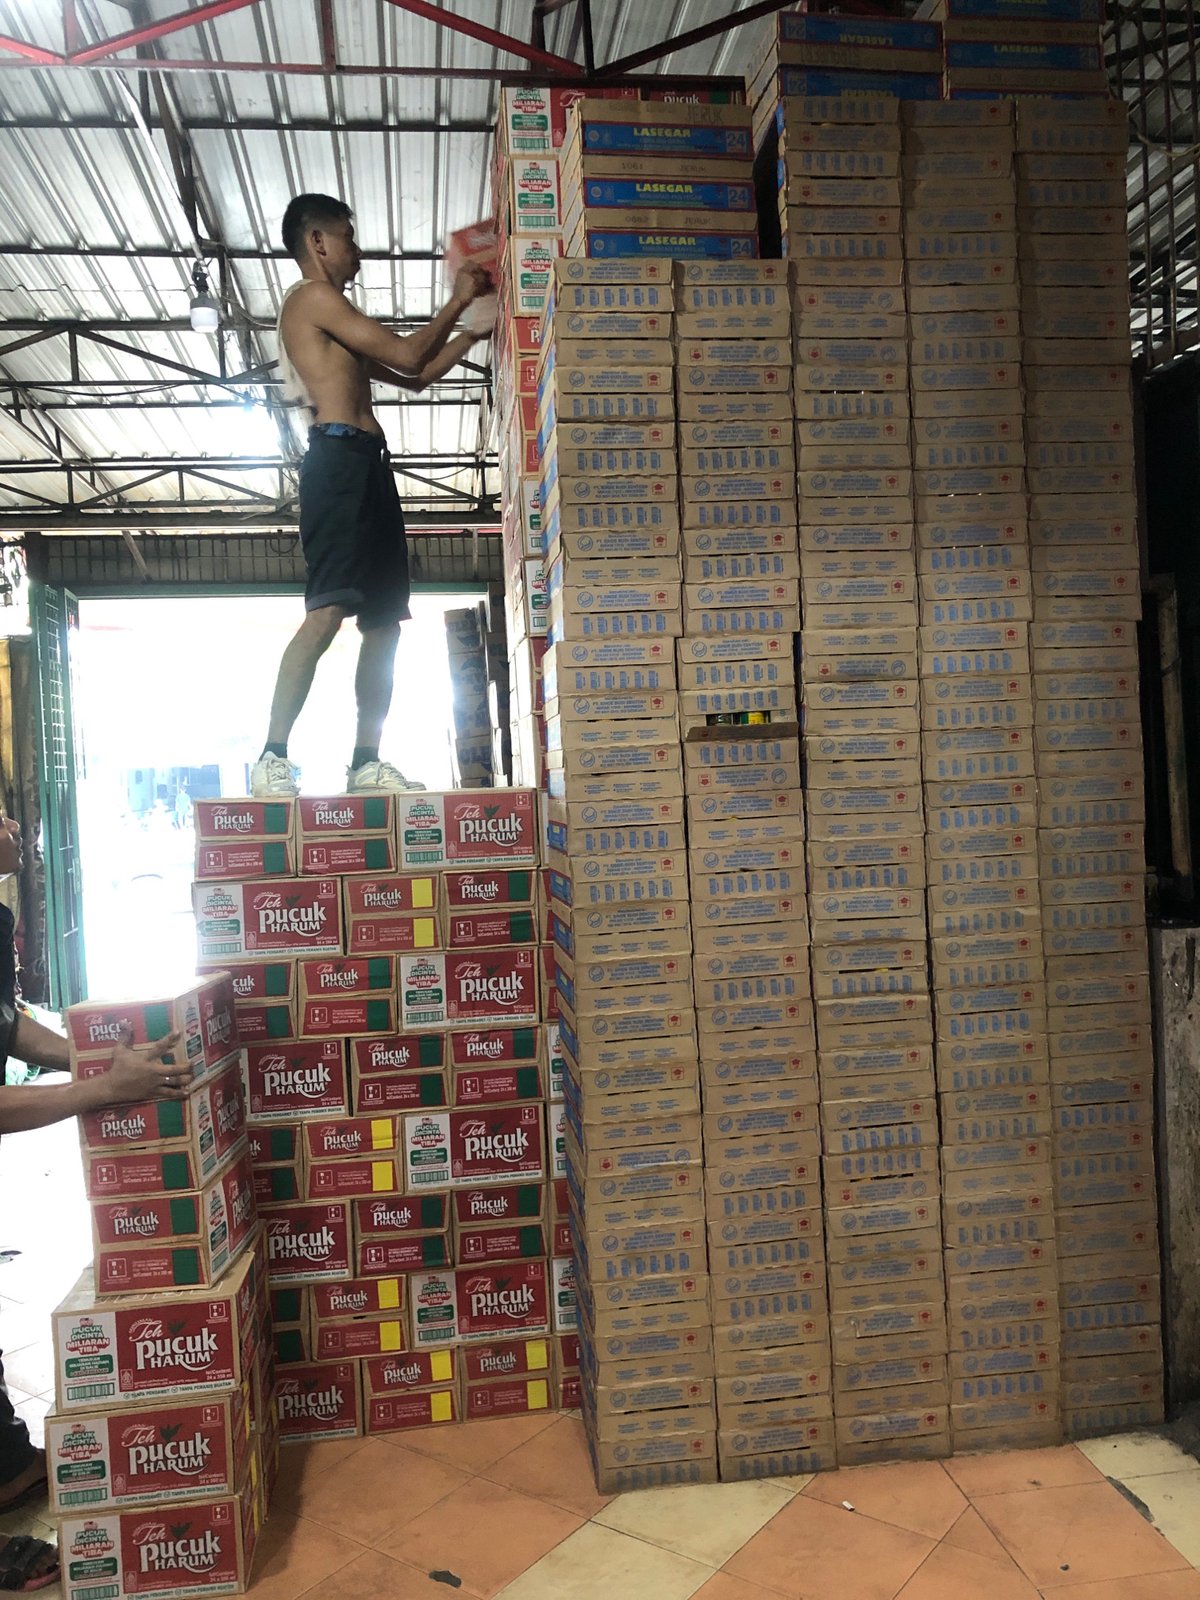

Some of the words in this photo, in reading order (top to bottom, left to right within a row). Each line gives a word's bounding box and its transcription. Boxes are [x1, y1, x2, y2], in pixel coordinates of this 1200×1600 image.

[633, 127, 691, 138] LASEGAR
[636, 183, 693, 194] LASEGAR
[729, 188, 748, 200] 24
[639, 235, 696, 246] LASEGAR
[732, 240, 750, 254] 24
[211, 806, 228, 816] Teh
[315, 808, 354, 825] pucuk
[454, 804, 480, 820] Teh
[214, 812, 254, 829] pucuk
[221, 823, 252, 832] HARUM
[322, 817, 352, 827] HARUM
[460, 813, 523, 843] pucuk
[471, 832, 520, 846] HARUM
[364, 889, 402, 906] pucuk
[462, 881, 499, 899] pucuk
[468, 890, 497, 900] HARUM
[253, 893, 281, 910] Teh
[370, 899, 400, 908] HARUM
[259, 901, 327, 933] pucuk
[271, 922, 323, 937] HARUM
[320, 969, 358, 987] pucuk
[455, 962, 481, 979] Teh
[233, 975, 255, 986] cuk
[460, 971, 524, 1002] pucuk
[233, 985, 252, 995] RUM
[472, 990, 520, 1005] HARUM
[466, 1038, 504, 1056] pucuk
[473, 1048, 502, 1058] HARUM
[259, 1055, 286, 1072] Teh
[372, 1047, 410, 1066] pucuk
[378, 1057, 408, 1067] HARUM
[264, 1063, 331, 1096] pucuk
[276, 1082, 328, 1098] HARUM
[101, 1114, 146, 1138] pucuk
[109, 1129, 143, 1139] HARUM
[460, 1120, 487, 1138] Teh
[324, 1131, 362, 1150] pucuk
[330, 1142, 359, 1151] HARUM
[411, 1134, 445, 1142] MILIARAN
[465, 1128, 528, 1160] pucuk
[477, 1147, 524, 1162] HARUM
[471, 1196, 508, 1215] pucuk
[477, 1206, 506, 1216] HARUM
[114, 1211, 159, 1235] pucuk
[373, 1207, 411, 1225] pucuk
[379, 1217, 409, 1227] HARUM
[122, 1224, 156, 1236] HARUM
[269, 1226, 335, 1259] pucuk
[281, 1246, 332, 1261] HARUM
[465, 1277, 492, 1294] Teh
[471, 1284, 535, 1316] pucuk
[483, 1303, 531, 1318] HARUM
[71, 1332, 104, 1341] DICINTA
[72, 1325, 103, 1334] PUCUK
[129, 1321, 163, 1342] Teh
[66, 1338, 110, 1350] MILIARAN
[79, 1345, 99, 1354] TIBA
[135, 1328, 218, 1370] pucuk
[151, 1352, 214, 1371] HARUM
[278, 1385, 344, 1419] pucuk
[290, 1405, 340, 1420] HARUM
[63, 1438, 97, 1447] DICINTA
[64, 1432, 96, 1440] PUCUK
[121, 1427, 156, 1447] Teh
[58, 1443, 102, 1455] MILIARAN
[71, 1451, 92, 1460] TIBA
[129, 1432, 211, 1475] pucuk
[144, 1456, 207, 1475] HARUM
[132, 1523, 167, 1545] Teh
[71, 1541, 114, 1552] MILIARAN
[82, 1549, 104, 1558] TIBA
[140, 1531, 222, 1572] pucuk
[155, 1554, 218, 1573] HARUM
